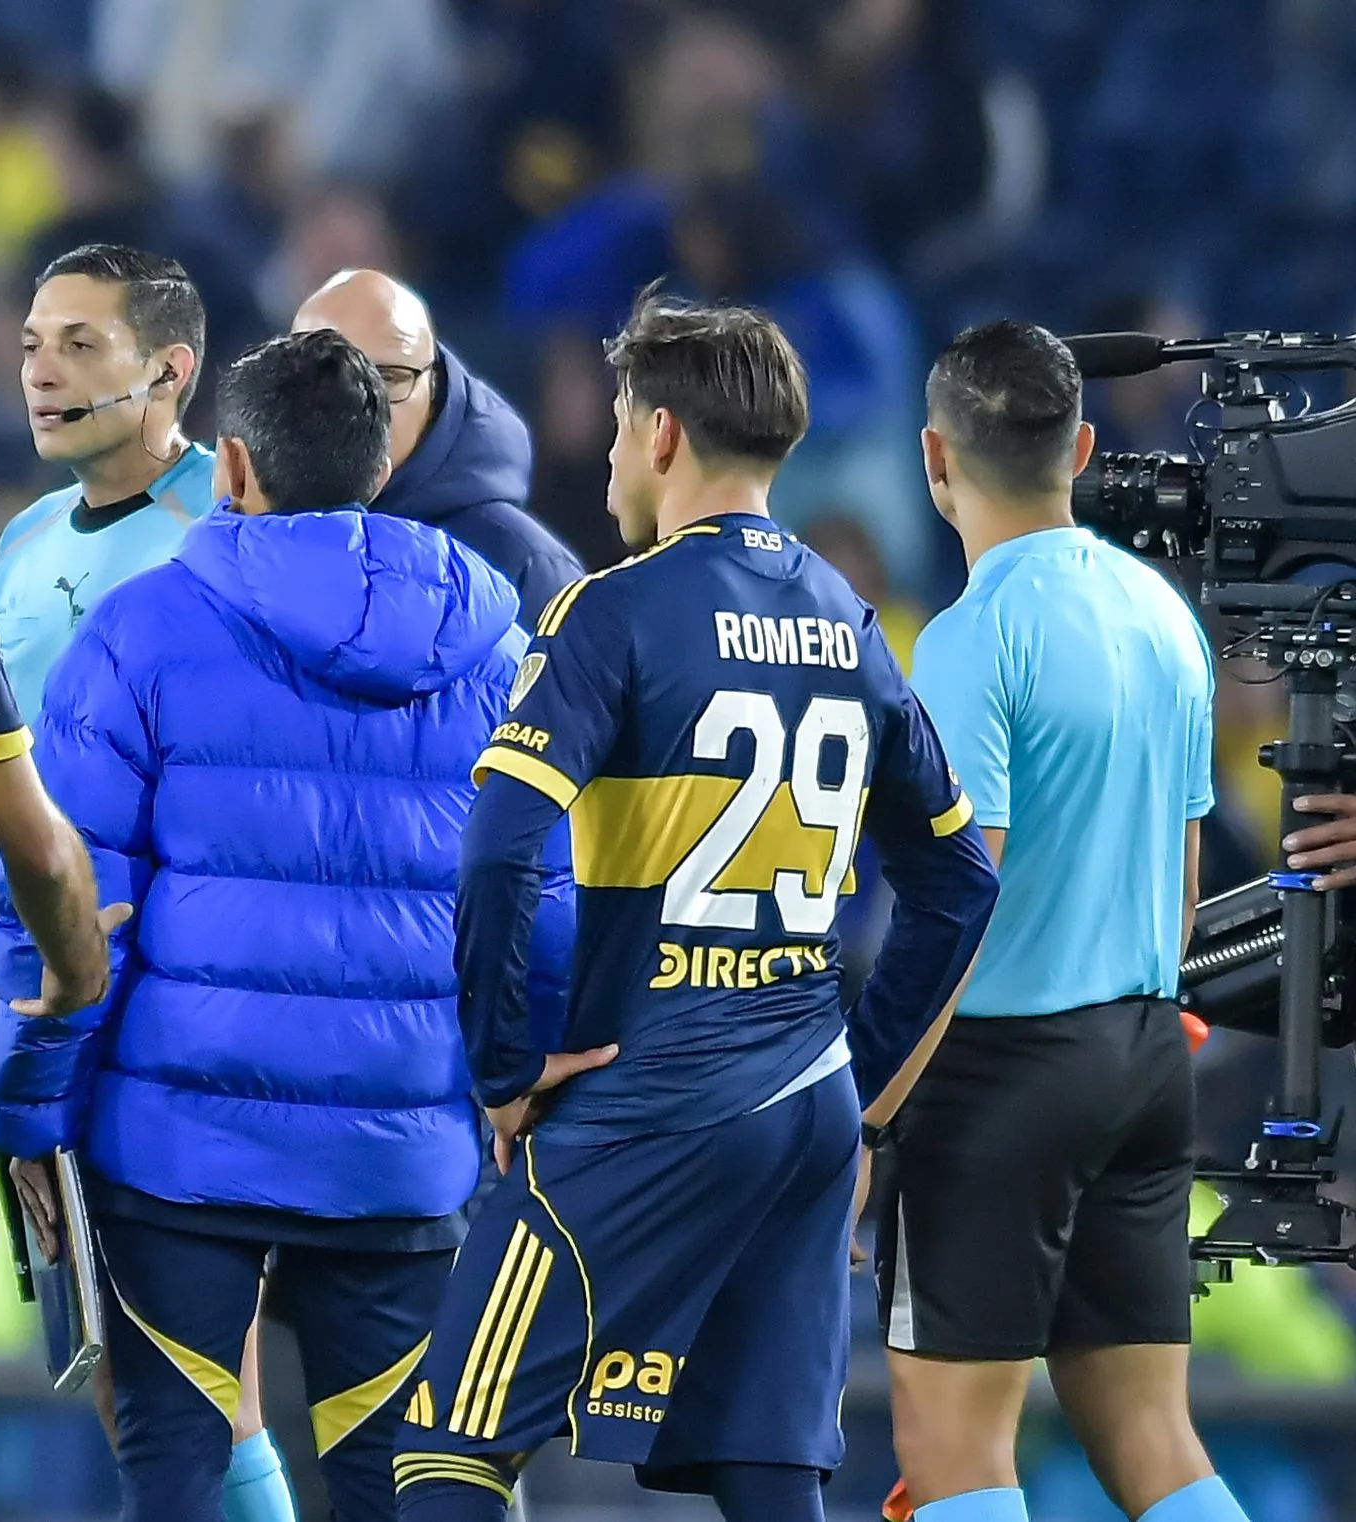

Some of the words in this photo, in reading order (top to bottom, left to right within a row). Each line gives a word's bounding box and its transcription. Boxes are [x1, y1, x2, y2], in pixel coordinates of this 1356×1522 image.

[741, 527, 783, 552] 1905
[714, 611, 859, 670] ROMERO
[660, 690, 869, 935] 29
[649, 942, 828, 989] DIRECTV
[589, 1350, 685, 1399] pa
